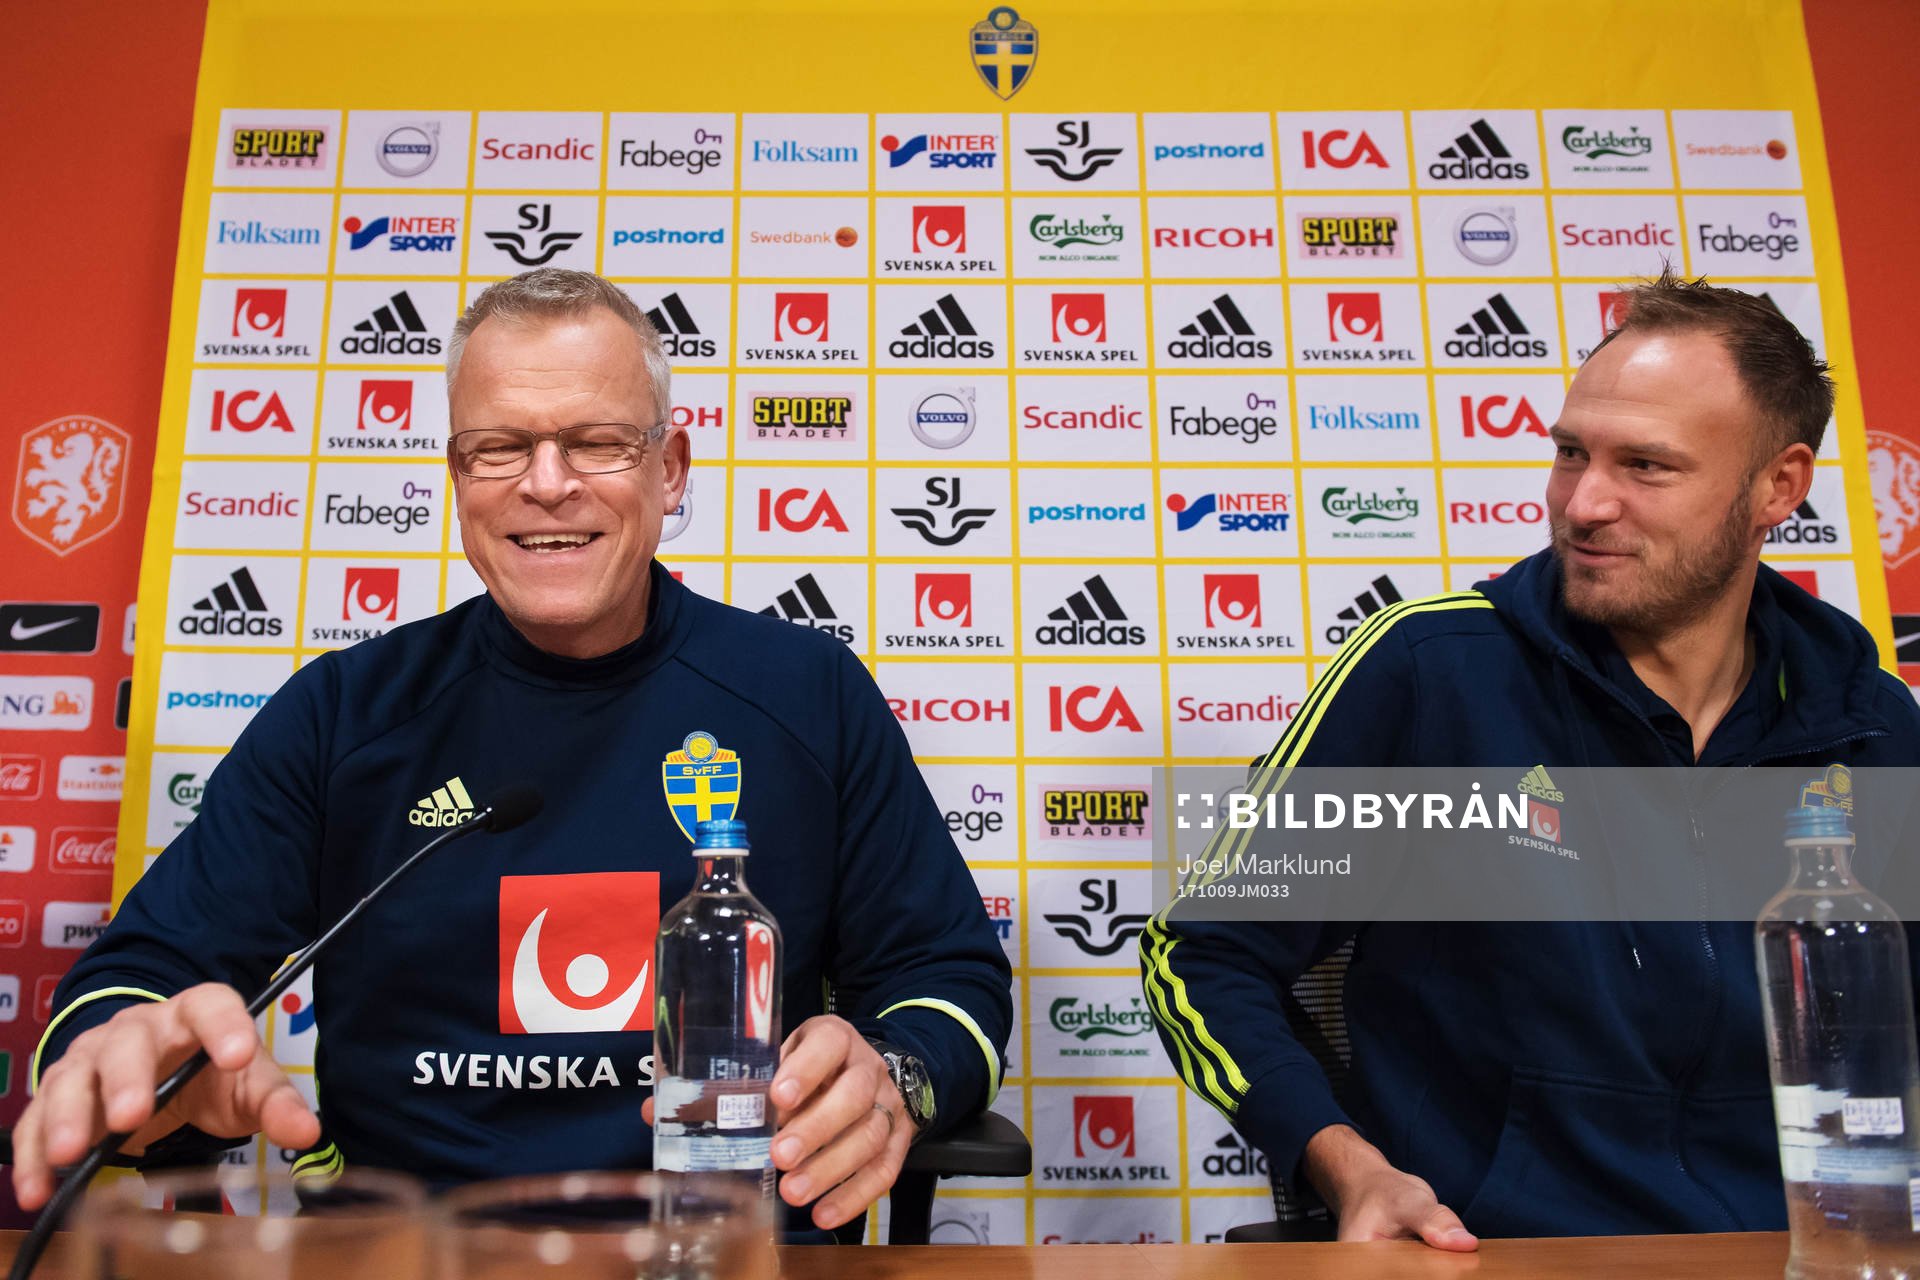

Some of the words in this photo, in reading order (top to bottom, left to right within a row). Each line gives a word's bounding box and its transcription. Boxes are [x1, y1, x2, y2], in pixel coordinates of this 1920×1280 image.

[233, 129, 324, 157] SPORT
[930, 135, 995, 151] INTER
[1057, 121, 1090, 148] SJ
[1562, 126, 1652, 154] Carlsberg
[482, 138, 595, 161] Scandic
[620, 140, 721, 174] Fabege
[752, 139, 858, 162] Folksam
[929, 152, 996, 168] SPORT
[1154, 142, 1264, 160] postnord
[1302, 130, 1390, 168] ICA
[236, 157, 317, 166] BLADET
[1429, 156, 1530, 180] adidas
[391, 217, 456, 234] INTER
[518, 204, 551, 232] SJ
[1030, 214, 1124, 242] Carlsberg
[218, 220, 320, 245] Folksam
[389, 235, 456, 252] SPORT
[613, 228, 724, 246] postnord
[750, 230, 831, 245] Swedbank
[1154, 228, 1274, 248] RICOH
[1304, 217, 1398, 246] SPORT
[1562, 223, 1675, 247] Scandic
[1700, 225, 1799, 260] Fabege
[1310, 246, 1395, 256] BLADET
[884, 260, 955, 271] SVENSKA
[960, 260, 997, 272] SPEL
[203, 344, 270, 356] SVENSKA
[277, 345, 311, 357] SPEL
[341, 332, 442, 356] adidas
[746, 348, 816, 360] SVENSKA
[822, 348, 859, 360] SPEL
[889, 334, 994, 360] adidas
[1024, 348, 1094, 362] SVENSKA
[1100, 349, 1138, 362] SPEL
[1168, 334, 1273, 360] adidas
[1302, 348, 1374, 362] SVENSKA
[1380, 349, 1416, 362] SPEL
[1444, 334, 1548, 359] adidas
[210, 390, 296, 432] ICA
[753, 397, 852, 428] SPORT
[917, 413, 967, 423] VOLVO
[1024, 405, 1143, 430] Scandic
[1309, 406, 1420, 430] Folksam
[1460, 395, 1550, 438] ICA
[758, 429, 848, 438] BLADET
[1170, 406, 1277, 444] Fabege
[328, 437, 397, 448] SVENSKA
[402, 438, 439, 450] SPEL
[184, 491, 300, 516] Scandic
[926, 476, 961, 509] SJ
[1219, 494, 1288, 511] INTER
[1322, 487, 1418, 518] Carlsberg
[325, 494, 430, 534] Fabege
[758, 488, 850, 533] ICA
[1028, 503, 1146, 524] postnord
[1451, 502, 1544, 524] RICO
[1219, 514, 1290, 532] SPORT
[179, 611, 282, 636] adidas
[1036, 620, 1146, 646] adidas
[885, 634, 960, 648] SVENSKA
[966, 635, 1005, 648] SPEL
[1177, 636, 1252, 648] SVENSKA
[1256, 636, 1295, 648] SPEL
[886, 698, 1010, 722] RICOH
[1049, 686, 1144, 734] ICA
[1178, 696, 1300, 722] Scandic
[682, 765, 722, 776] SvFF
[1517, 782, 1564, 803] adidas
[408, 808, 476, 828] adida
[1044, 791, 1149, 826] SPORT
[1050, 826, 1145, 836] BLADET
[1508, 836, 1556, 854] SVENSKA
[1558, 848, 1580, 861] SPEL
[1080, 879, 1117, 914] SJ
[1050, 997, 1154, 1034] Carlsberg
[413, 1052, 620, 1089] SVENSKA
[1043, 1166, 1124, 1181] SVENSKA
[1128, 1166, 1170, 1181] SPEL
